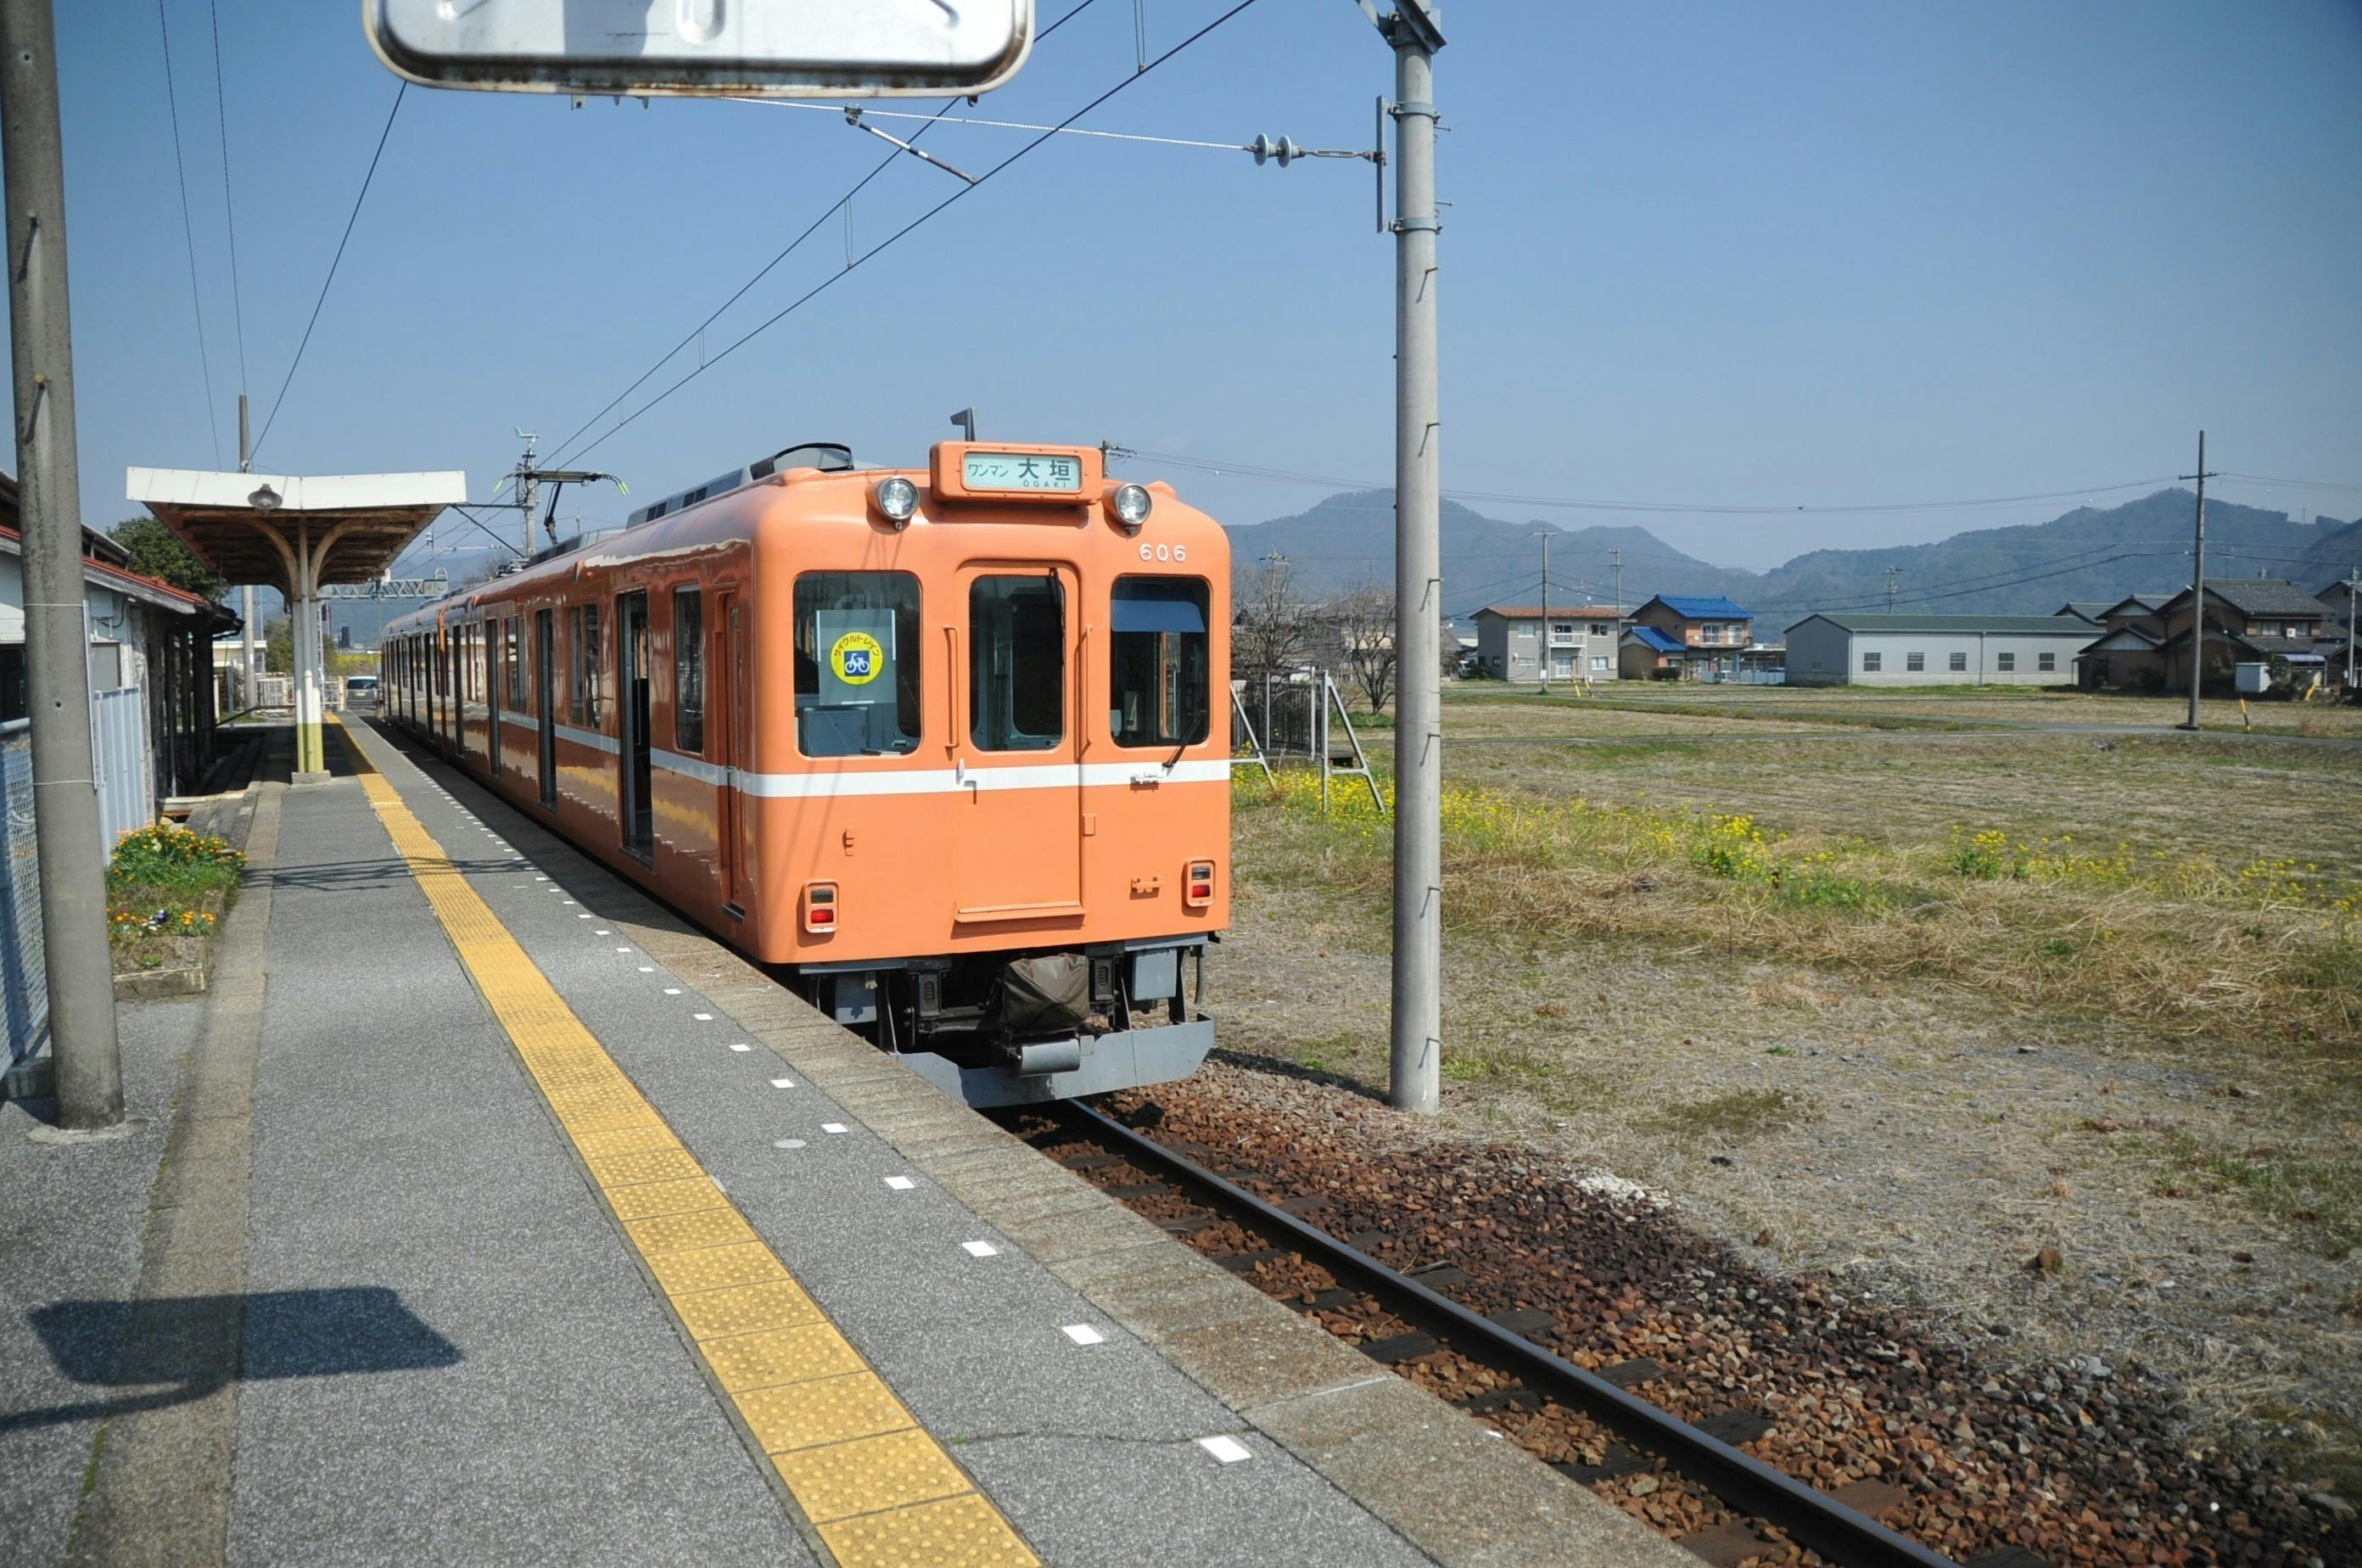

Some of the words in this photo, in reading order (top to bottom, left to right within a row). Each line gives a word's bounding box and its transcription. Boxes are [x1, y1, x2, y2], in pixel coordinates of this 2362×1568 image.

[968, 463, 1009, 478] ワンマン
[1018, 457, 1071, 481] 大垣
[1022, 479, 1066, 489] OGAKI
[1139, 543, 1186, 562] 606
[833, 635, 880, 657] サイクルトレイン
